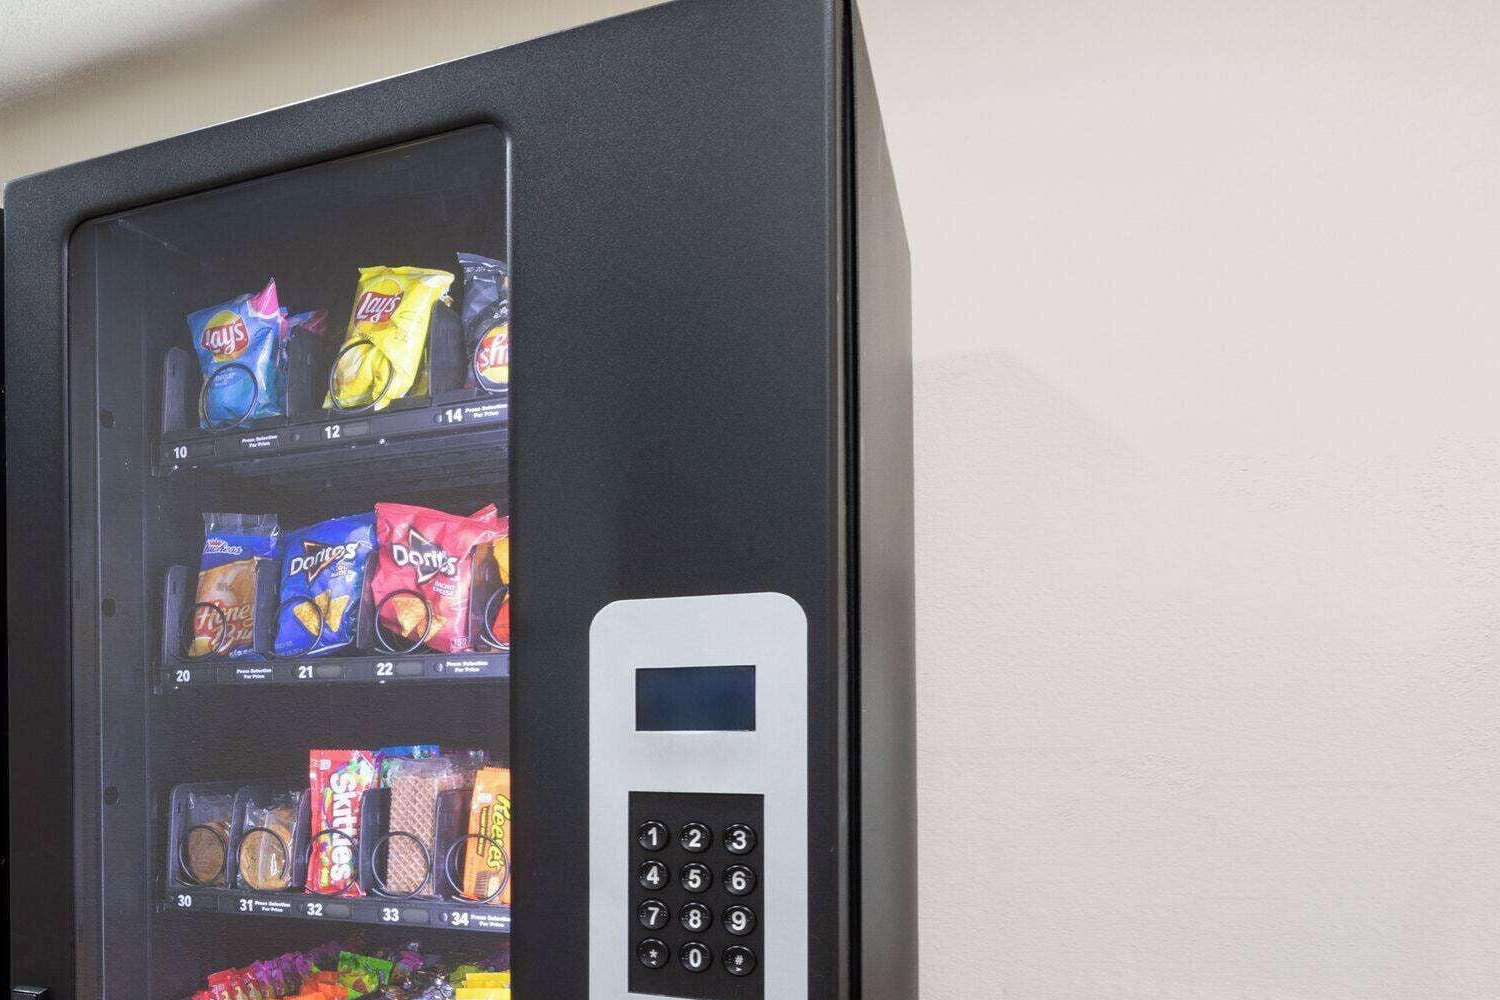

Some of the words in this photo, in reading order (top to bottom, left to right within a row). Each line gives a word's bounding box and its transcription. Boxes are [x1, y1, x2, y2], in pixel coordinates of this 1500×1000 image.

[356, 292, 402, 322] Lay's
[446, 408, 462, 423] 14
[325, 425, 340, 438] 12
[174, 446, 188, 459] 10
[290, 543, 358, 577] Doritos
[393, 544, 459, 577] Doritos
[298, 665, 313, 679] 21
[376, 662, 393, 676] 22
[176, 670, 191, 683] 20
[647, 826, 657, 846] 1
[688, 828, 701, 848] 2
[732, 830, 747, 850] 3
[646, 865, 659, 885] 4
[688, 869, 701, 889] 5
[732, 871, 746, 890] 6
[177, 894, 192, 907] 30
[240, 899, 253, 911] 31
[306, 902, 323, 916] 32
[382, 908, 399, 921] 33
[451, 911, 469, 926] 34
[648, 907, 660, 925] 7
[688, 909, 702, 929] 8
[731, 911, 746, 930] 9
[688, 948, 702, 968] 0
